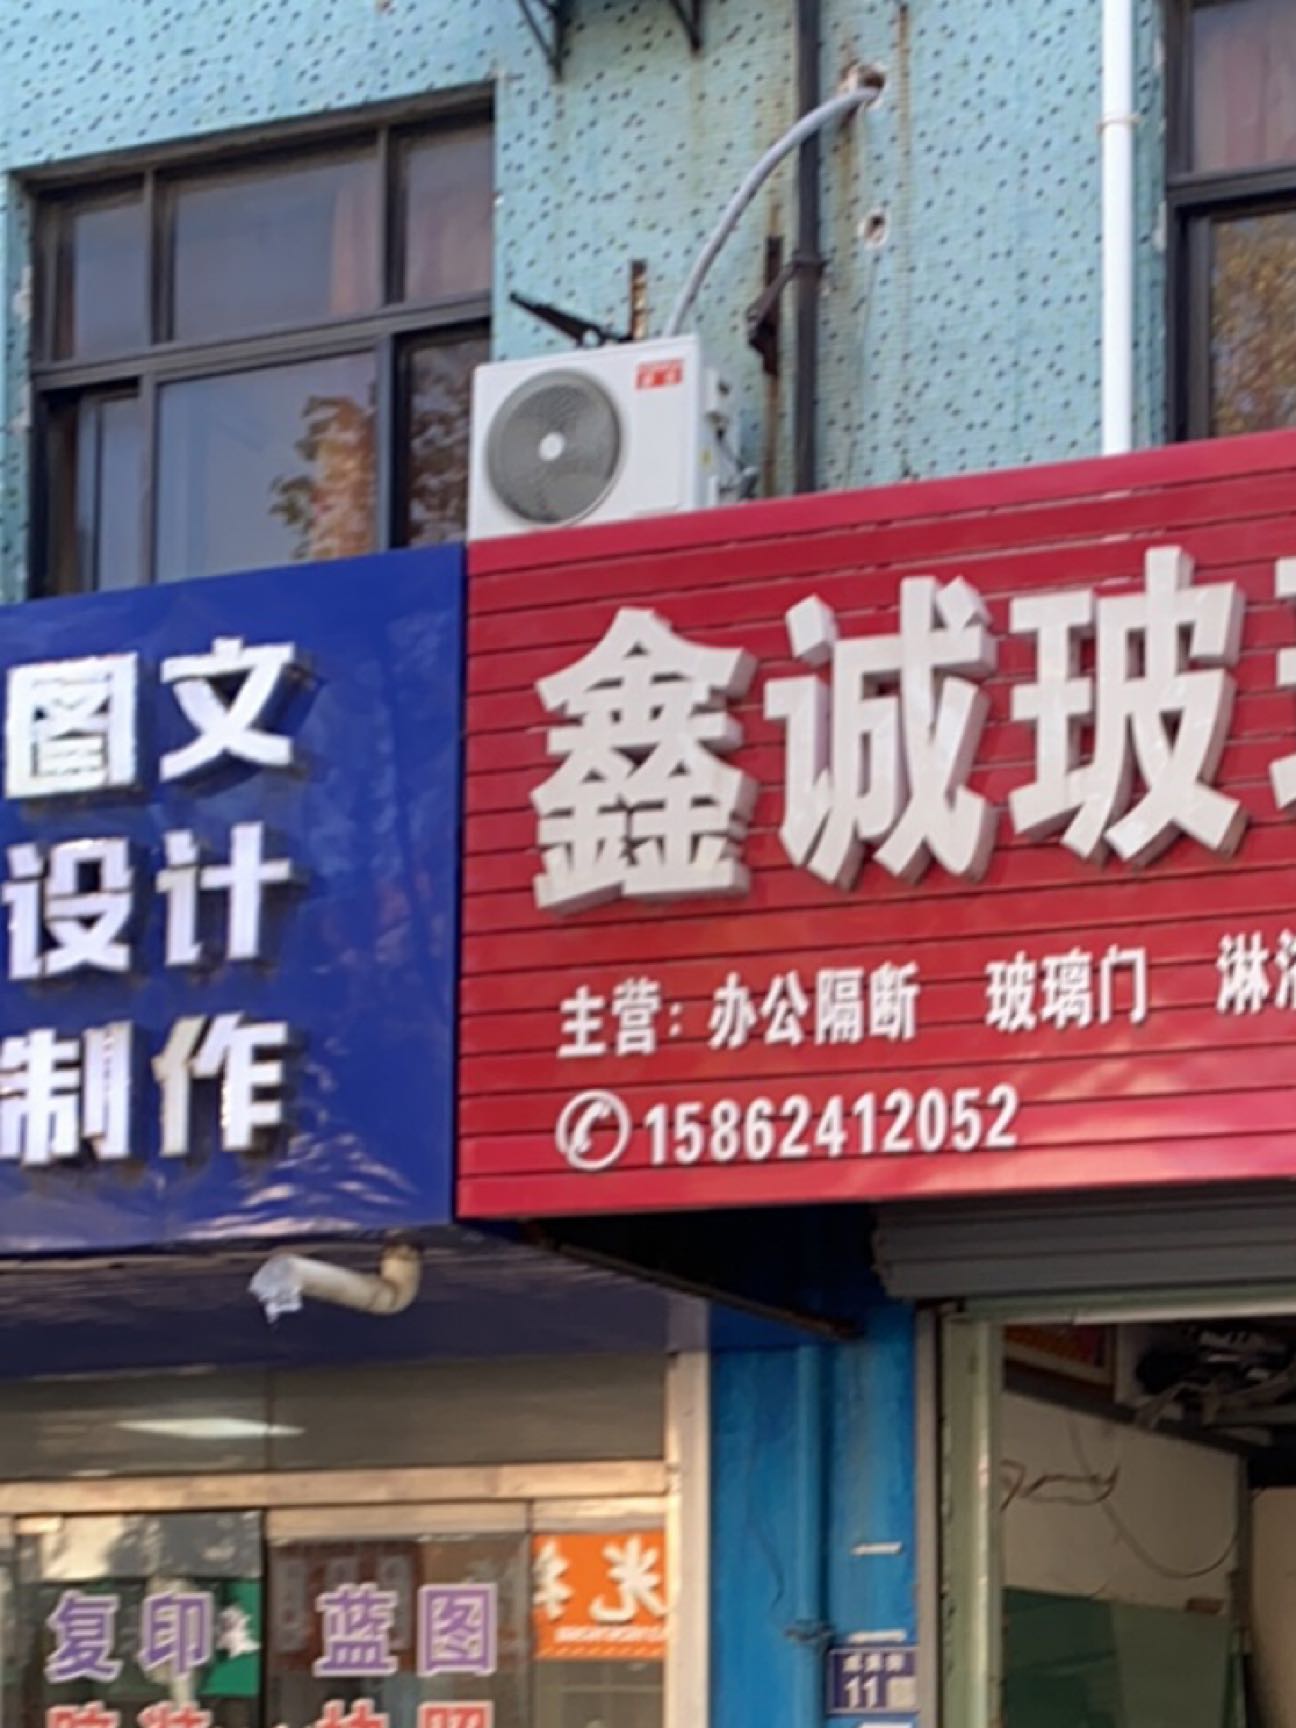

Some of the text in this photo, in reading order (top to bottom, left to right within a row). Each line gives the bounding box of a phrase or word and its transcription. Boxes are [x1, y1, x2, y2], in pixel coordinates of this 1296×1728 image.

[3, 822, 293, 981] 设计
[985, 945, 1149, 1033] 玻璃门
[0, 1012, 290, 1167] 制作
[643, 1085, 1020, 1166] 15862412052
[45, 1590, 216, 1683] 复印
[313, 1582, 499, 1677] 蓝图
